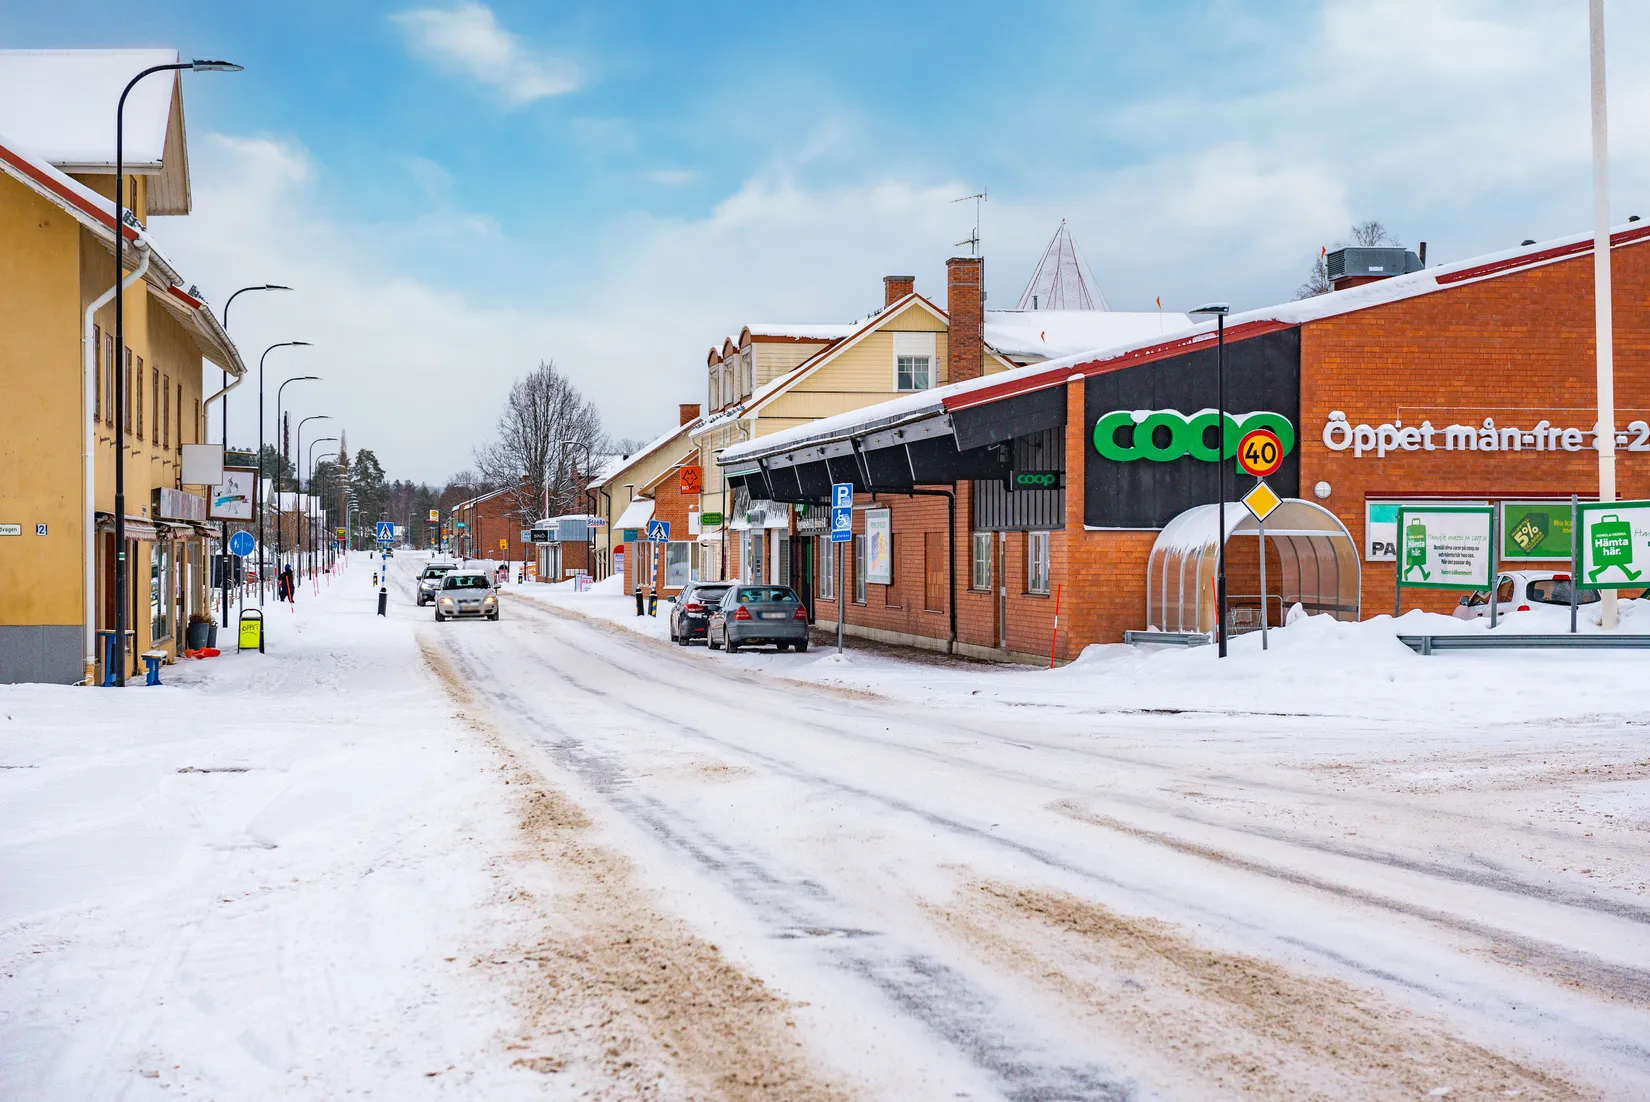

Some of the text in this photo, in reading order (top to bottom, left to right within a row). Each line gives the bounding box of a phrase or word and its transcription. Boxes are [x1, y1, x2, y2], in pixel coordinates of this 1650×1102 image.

[1093, 409, 1295, 474] coop
[1323, 411, 1435, 457] Öppet
[1446, 417, 1583, 451] mån-fre
[1245, 442, 1277, 464] 40
[1017, 474, 1055, 486] coop
[838, 486, 849, 505] P
[1407, 540, 1425, 548] Hämta
[1513, 522, 1539, 548] 5%
[1594, 538, 1629, 548] Hämta
[1603, 547, 1622, 556] här.
